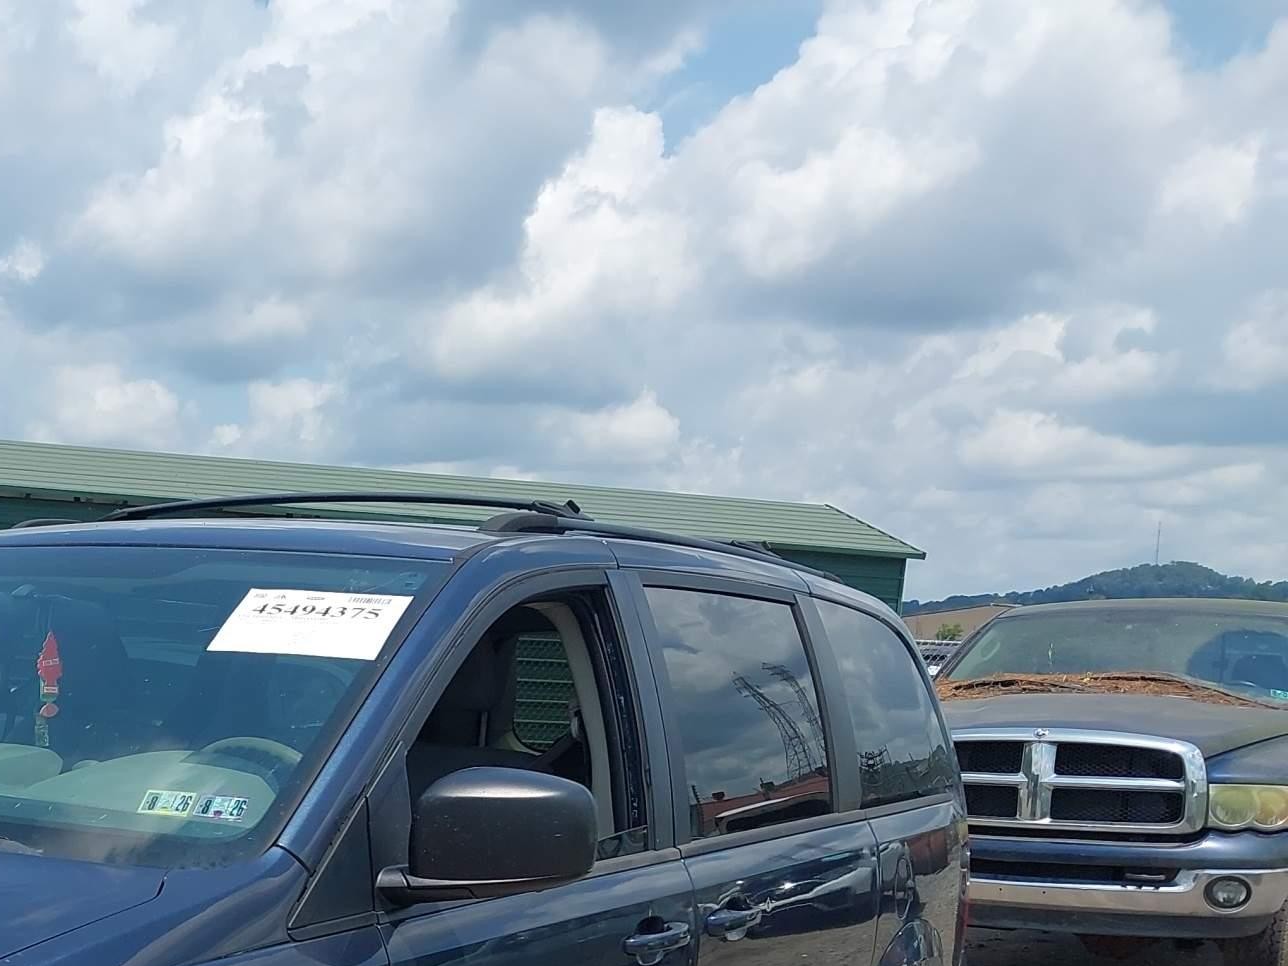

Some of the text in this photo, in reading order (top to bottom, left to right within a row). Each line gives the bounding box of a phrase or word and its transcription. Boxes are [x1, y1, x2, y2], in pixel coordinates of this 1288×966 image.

[252, 602, 383, 620] 45494375
[175, 795, 193, 813] 26
[229, 799, 247, 816] 26
